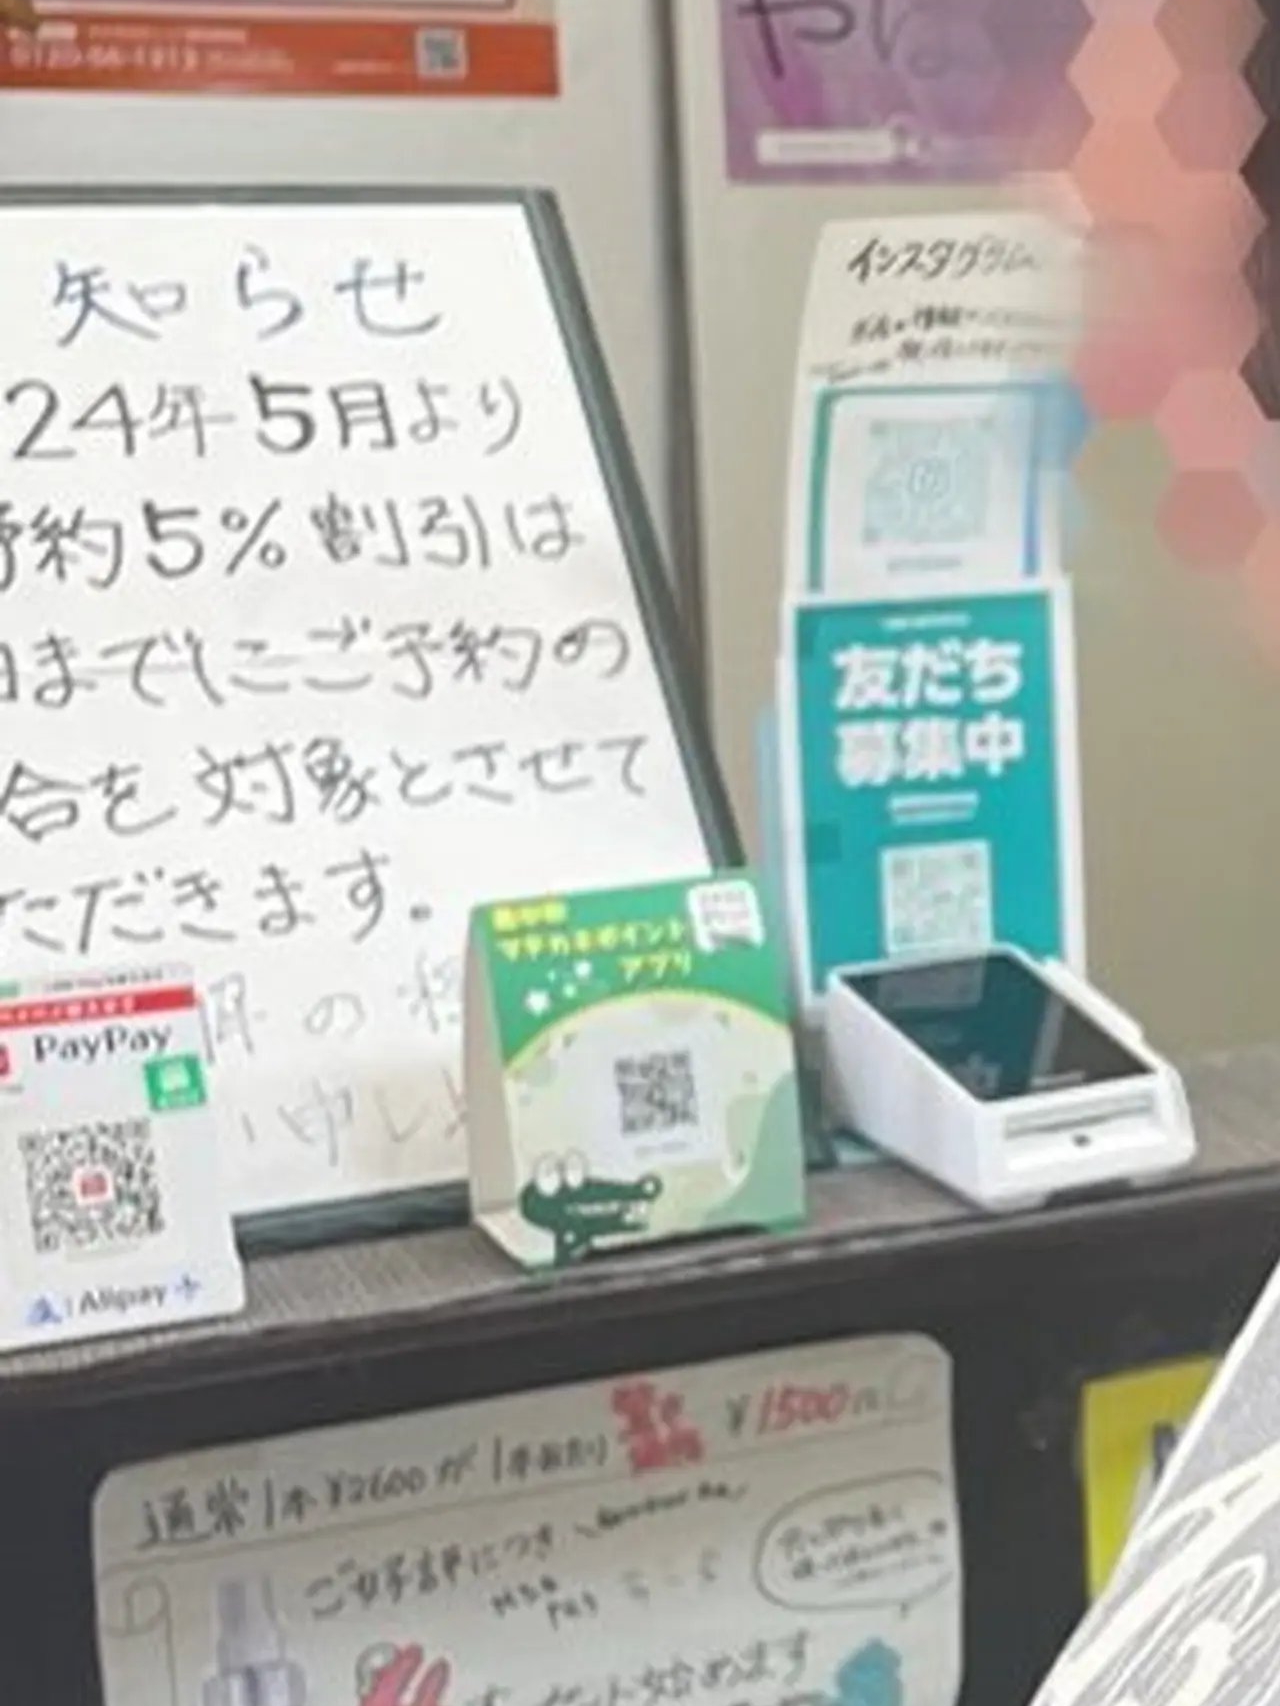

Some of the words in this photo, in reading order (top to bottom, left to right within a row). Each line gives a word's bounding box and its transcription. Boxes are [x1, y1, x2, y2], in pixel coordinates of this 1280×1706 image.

[52, 242, 443, 347] 知らせ
[832, 636, 1024, 709] 友だち
[835, 711, 1026, 787] 募集中
[32, 1022, 173, 1064] PayPay
